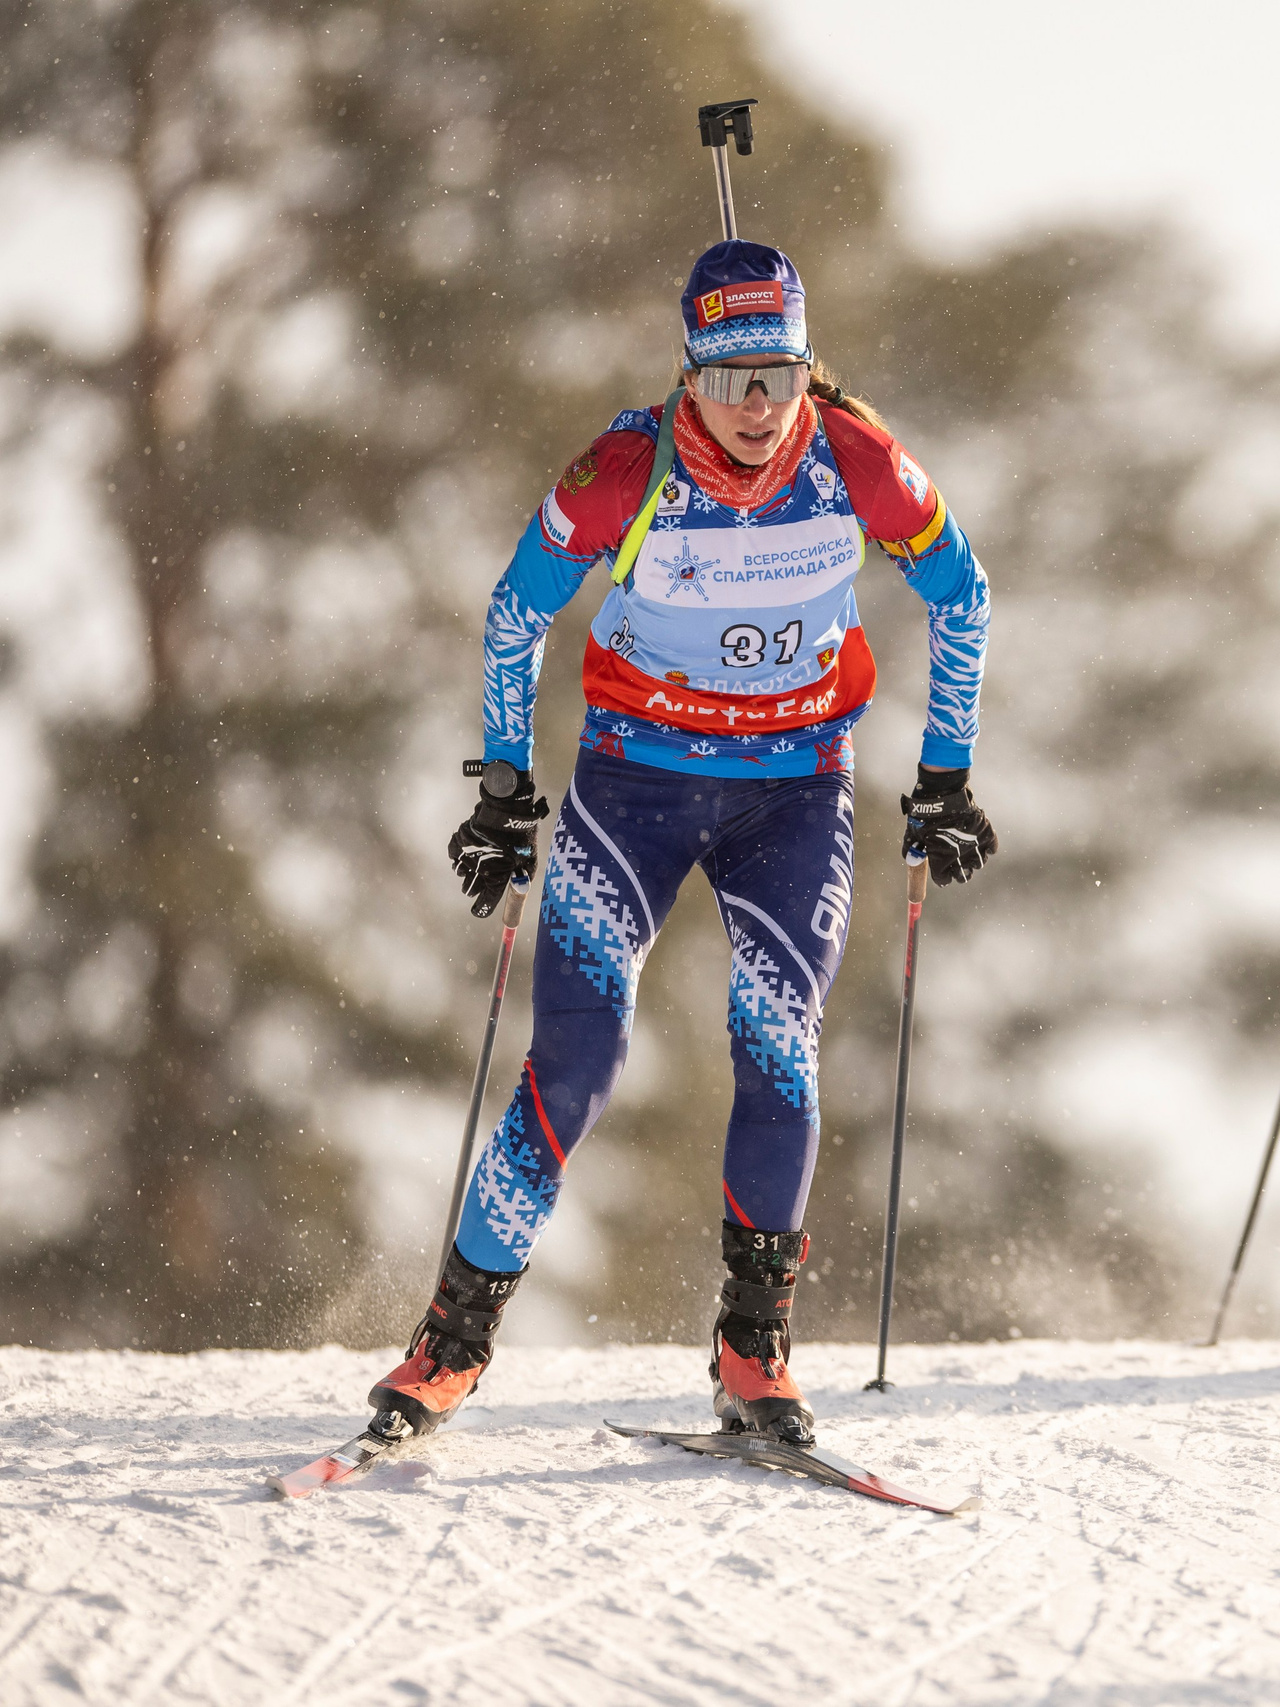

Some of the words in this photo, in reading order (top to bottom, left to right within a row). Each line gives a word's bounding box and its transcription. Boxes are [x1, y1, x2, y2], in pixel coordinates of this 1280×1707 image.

[726, 291, 774, 303] ЗЛАТОУСТ
[713, 560, 827, 583] СПАРТАКИАДА
[720, 619, 803, 668] 31
[697, 658, 812, 695] ЗЛАТОУСТ
[753, 1233, 779, 1251] 31
